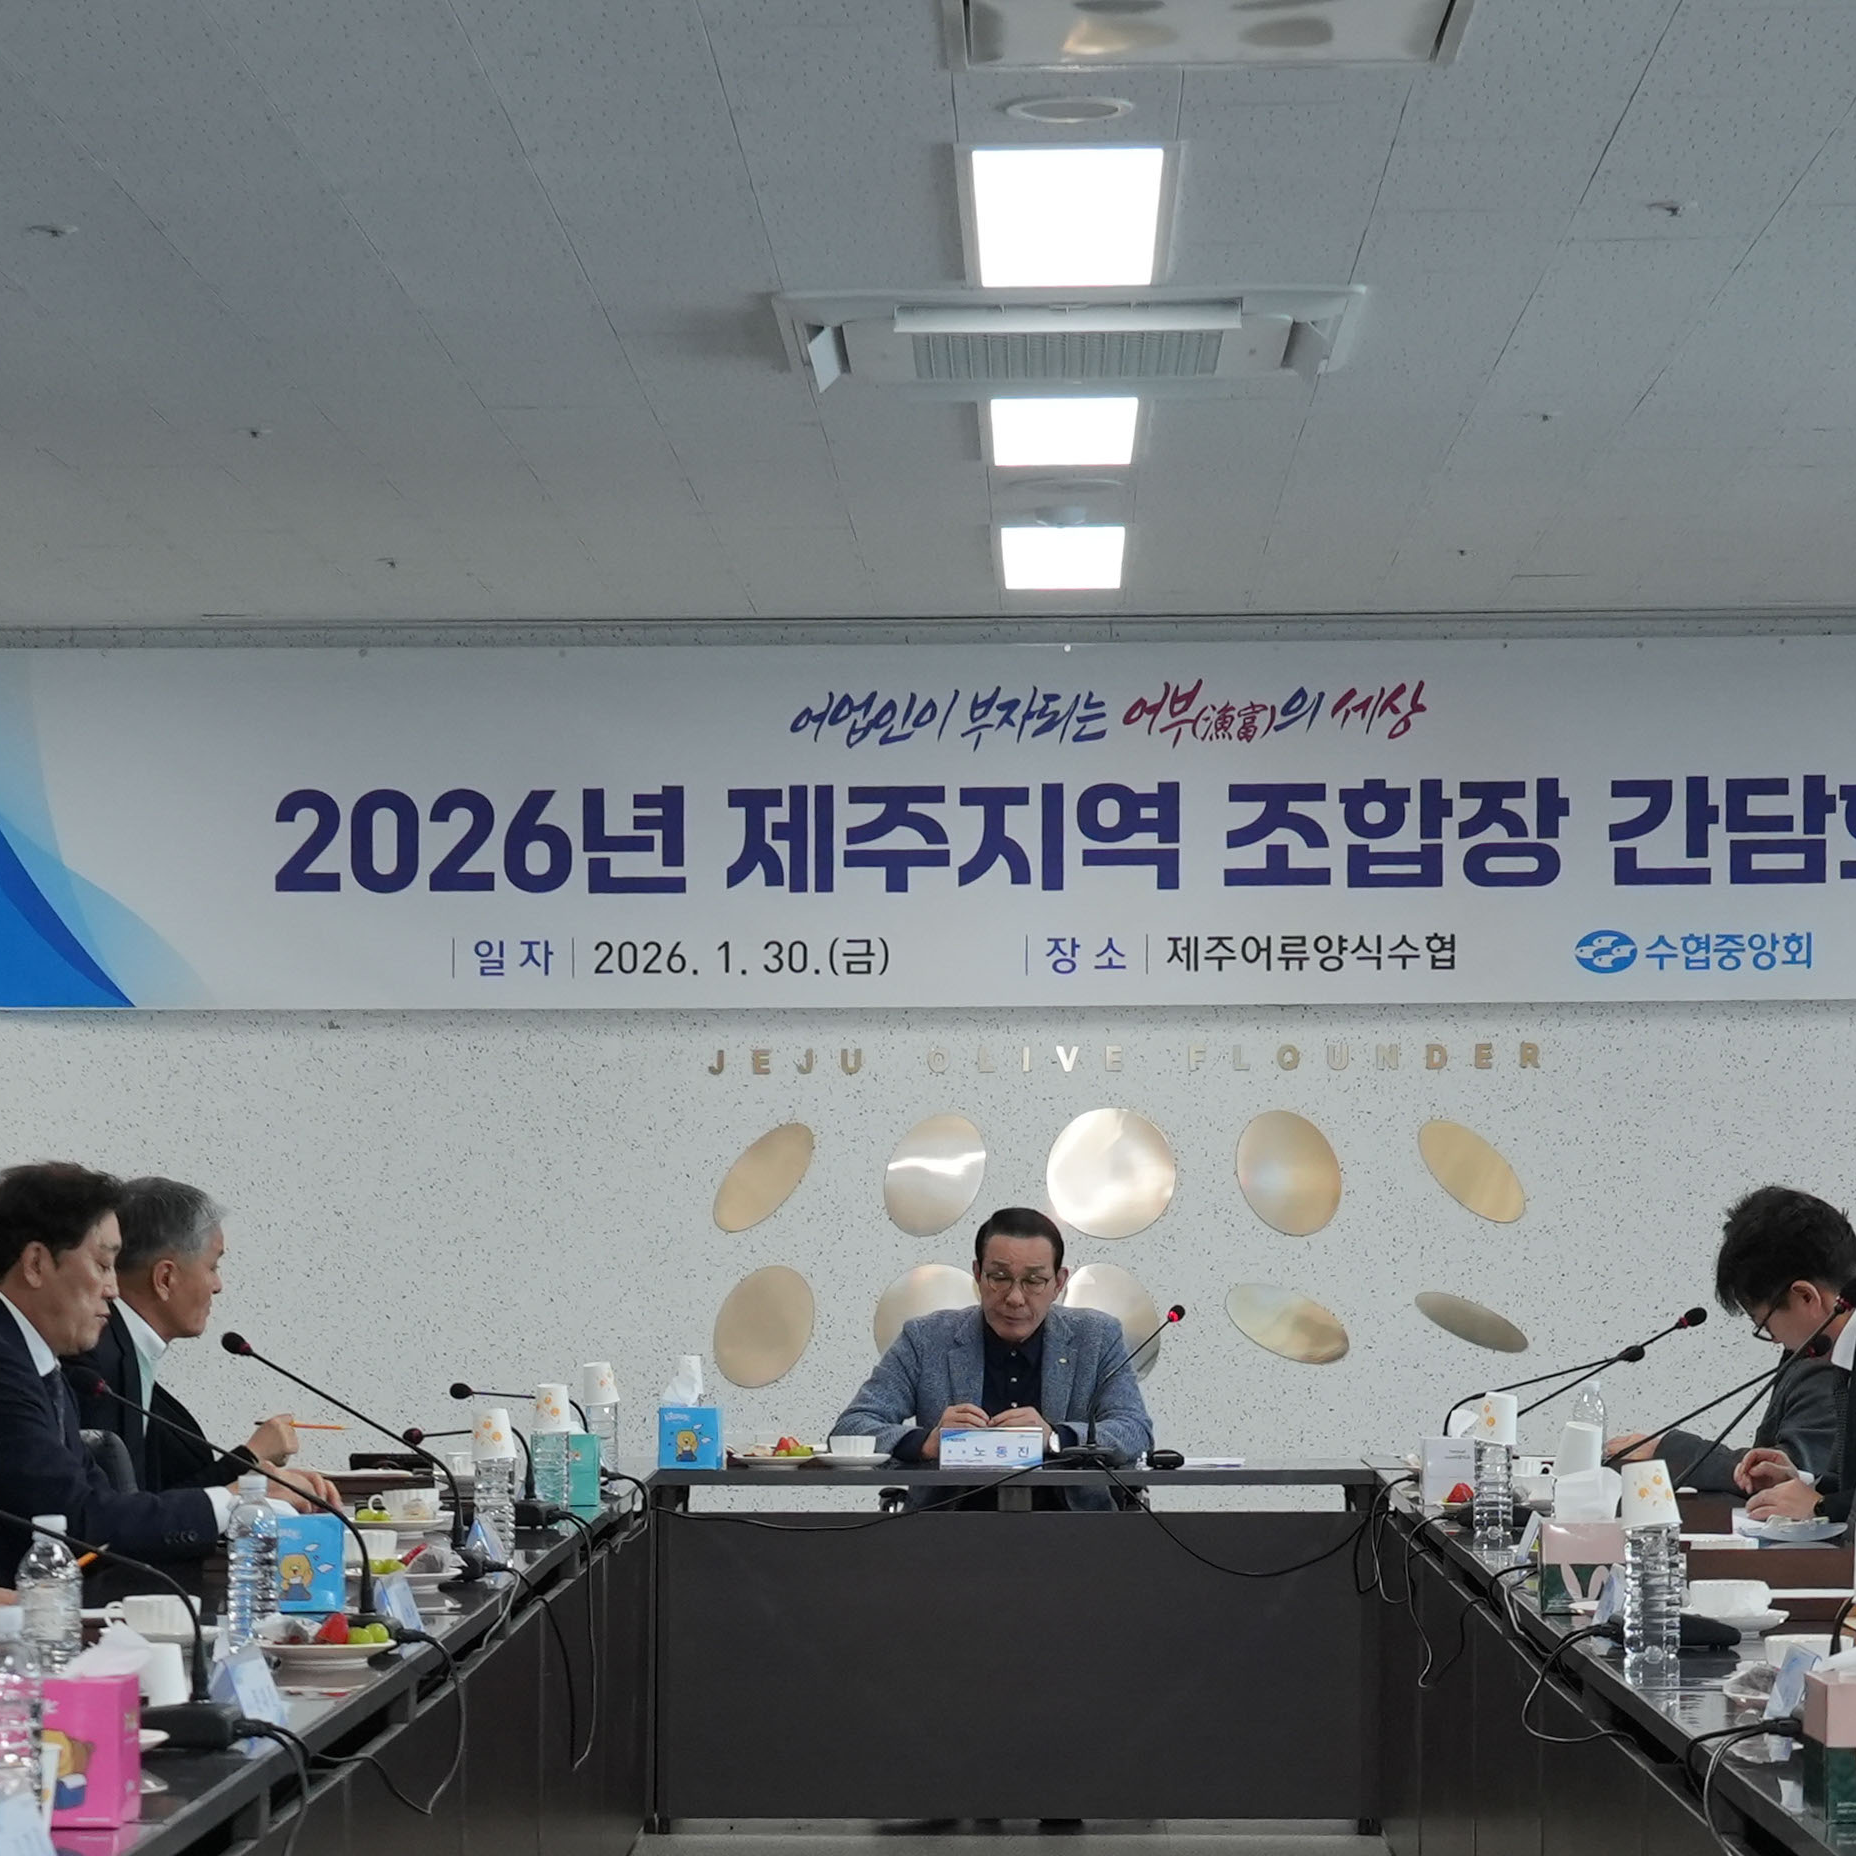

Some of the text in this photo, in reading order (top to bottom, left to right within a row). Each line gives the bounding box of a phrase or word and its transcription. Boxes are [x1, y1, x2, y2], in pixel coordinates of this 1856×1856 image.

[790, 678, 1427, 751] 어업인이 부자되는 어부(漁富)의 세상
[275, 785, 686, 894] 2026년
[727, 782, 1180, 893] 제주지역
[1224, 778, 1569, 888] 조합장
[594, 938, 890, 976] 2026. 1. 30.(금)
[1167, 932, 1456, 972] 제주어류양식수협
[1646, 932, 1812, 971] 수협중앙회
[707, 1042, 1540, 1076] JEJU OLIVE FLOUNDER
